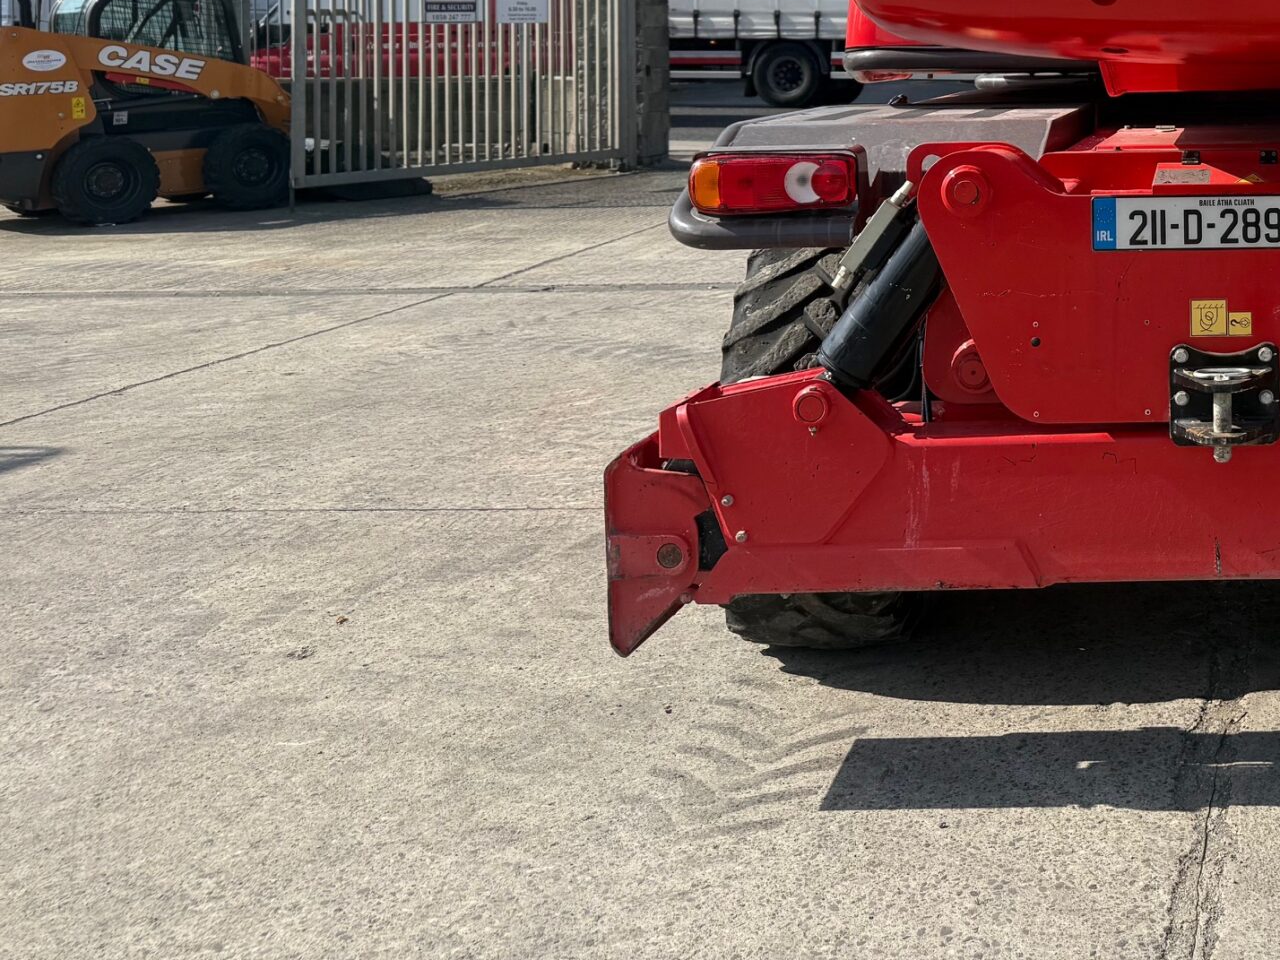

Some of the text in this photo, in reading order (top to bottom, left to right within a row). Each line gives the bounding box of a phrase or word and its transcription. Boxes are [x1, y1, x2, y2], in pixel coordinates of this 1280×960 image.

[98, 44, 206, 81] CASE
[0, 80, 79, 97] SR175B
[1096, 230, 1113, 242] IRL
